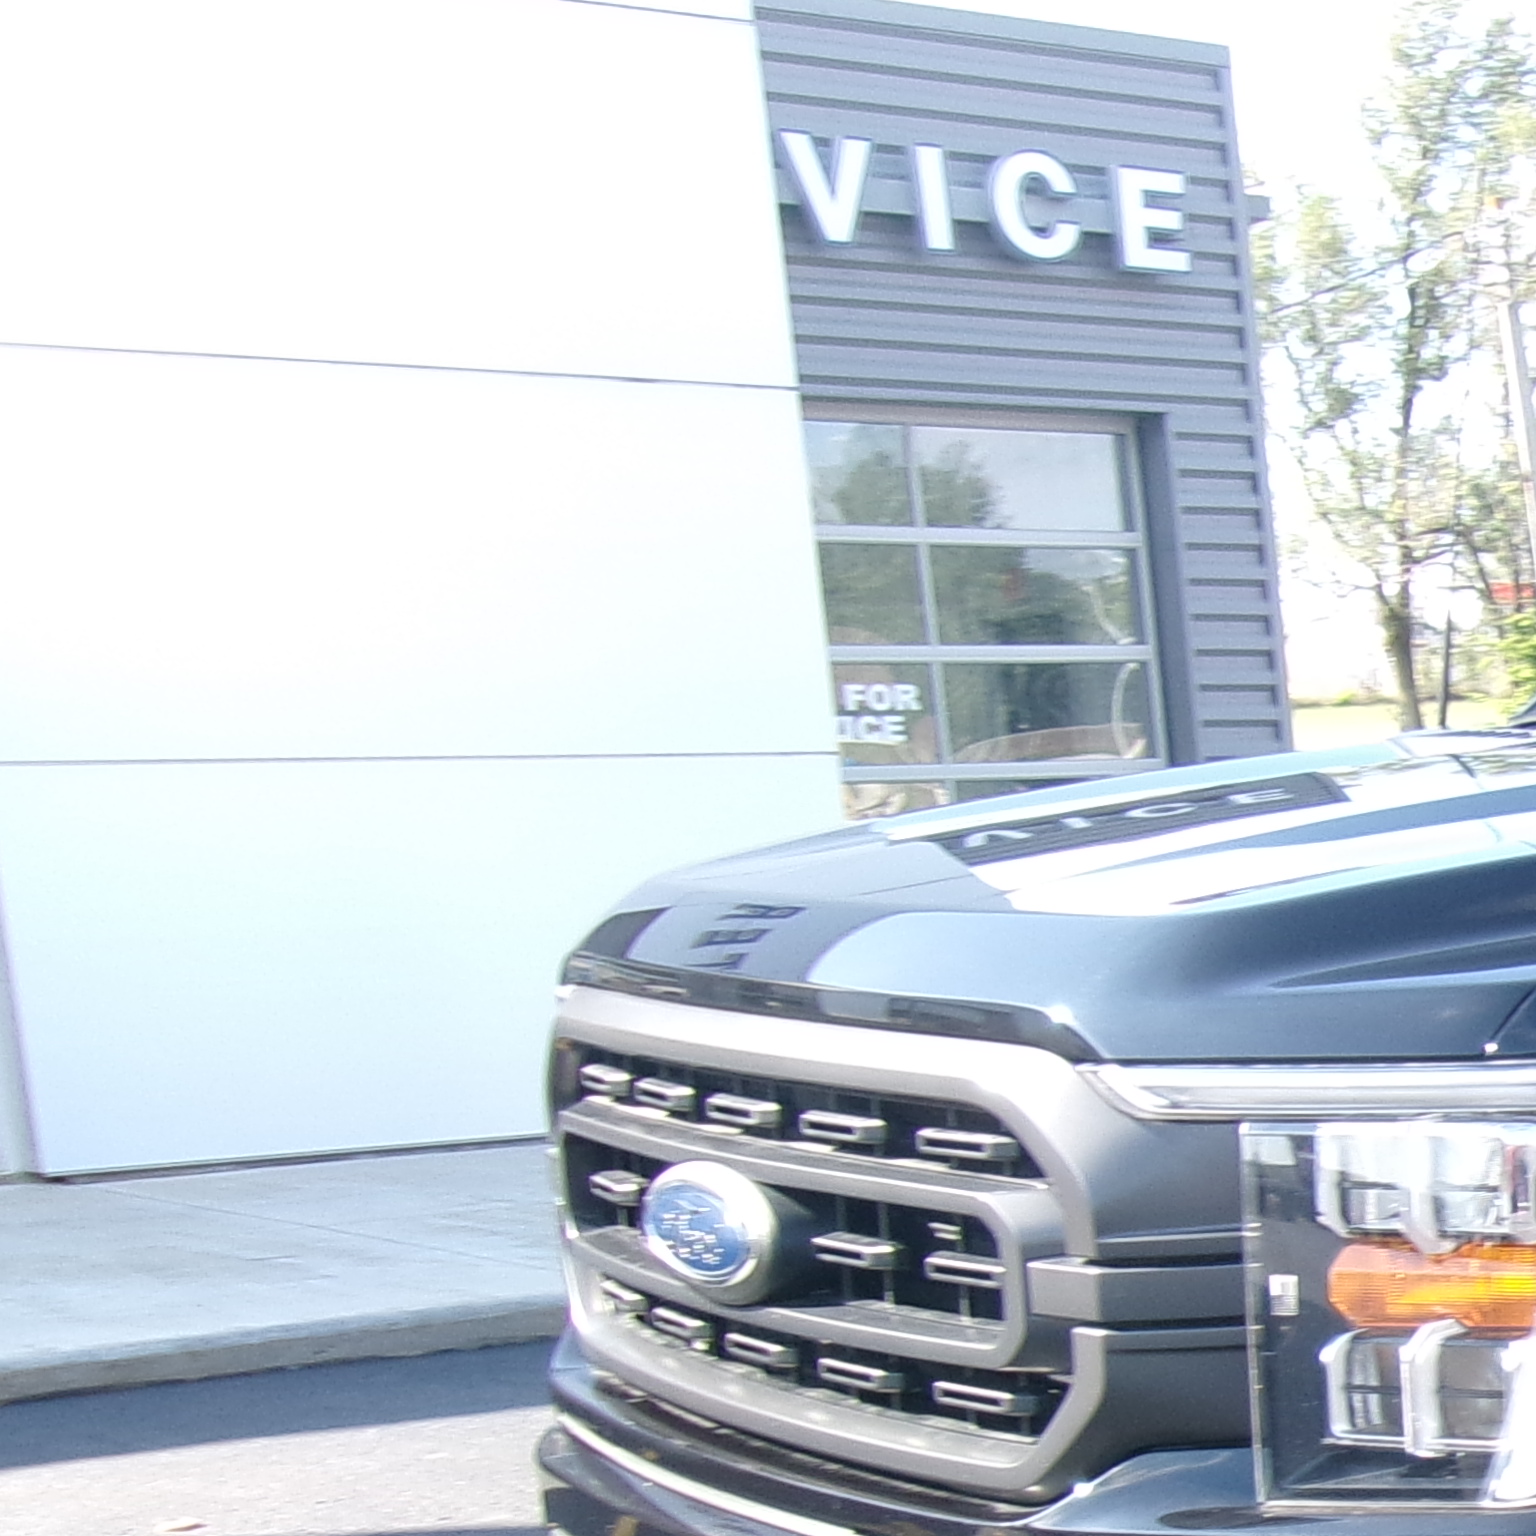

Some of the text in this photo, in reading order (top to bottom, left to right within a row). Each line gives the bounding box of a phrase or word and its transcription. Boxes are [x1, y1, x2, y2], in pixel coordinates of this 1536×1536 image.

[779, 128, 1193, 273] VICE
[842, 683, 923, 711] FOR
[834, 715, 908, 741] ICE
